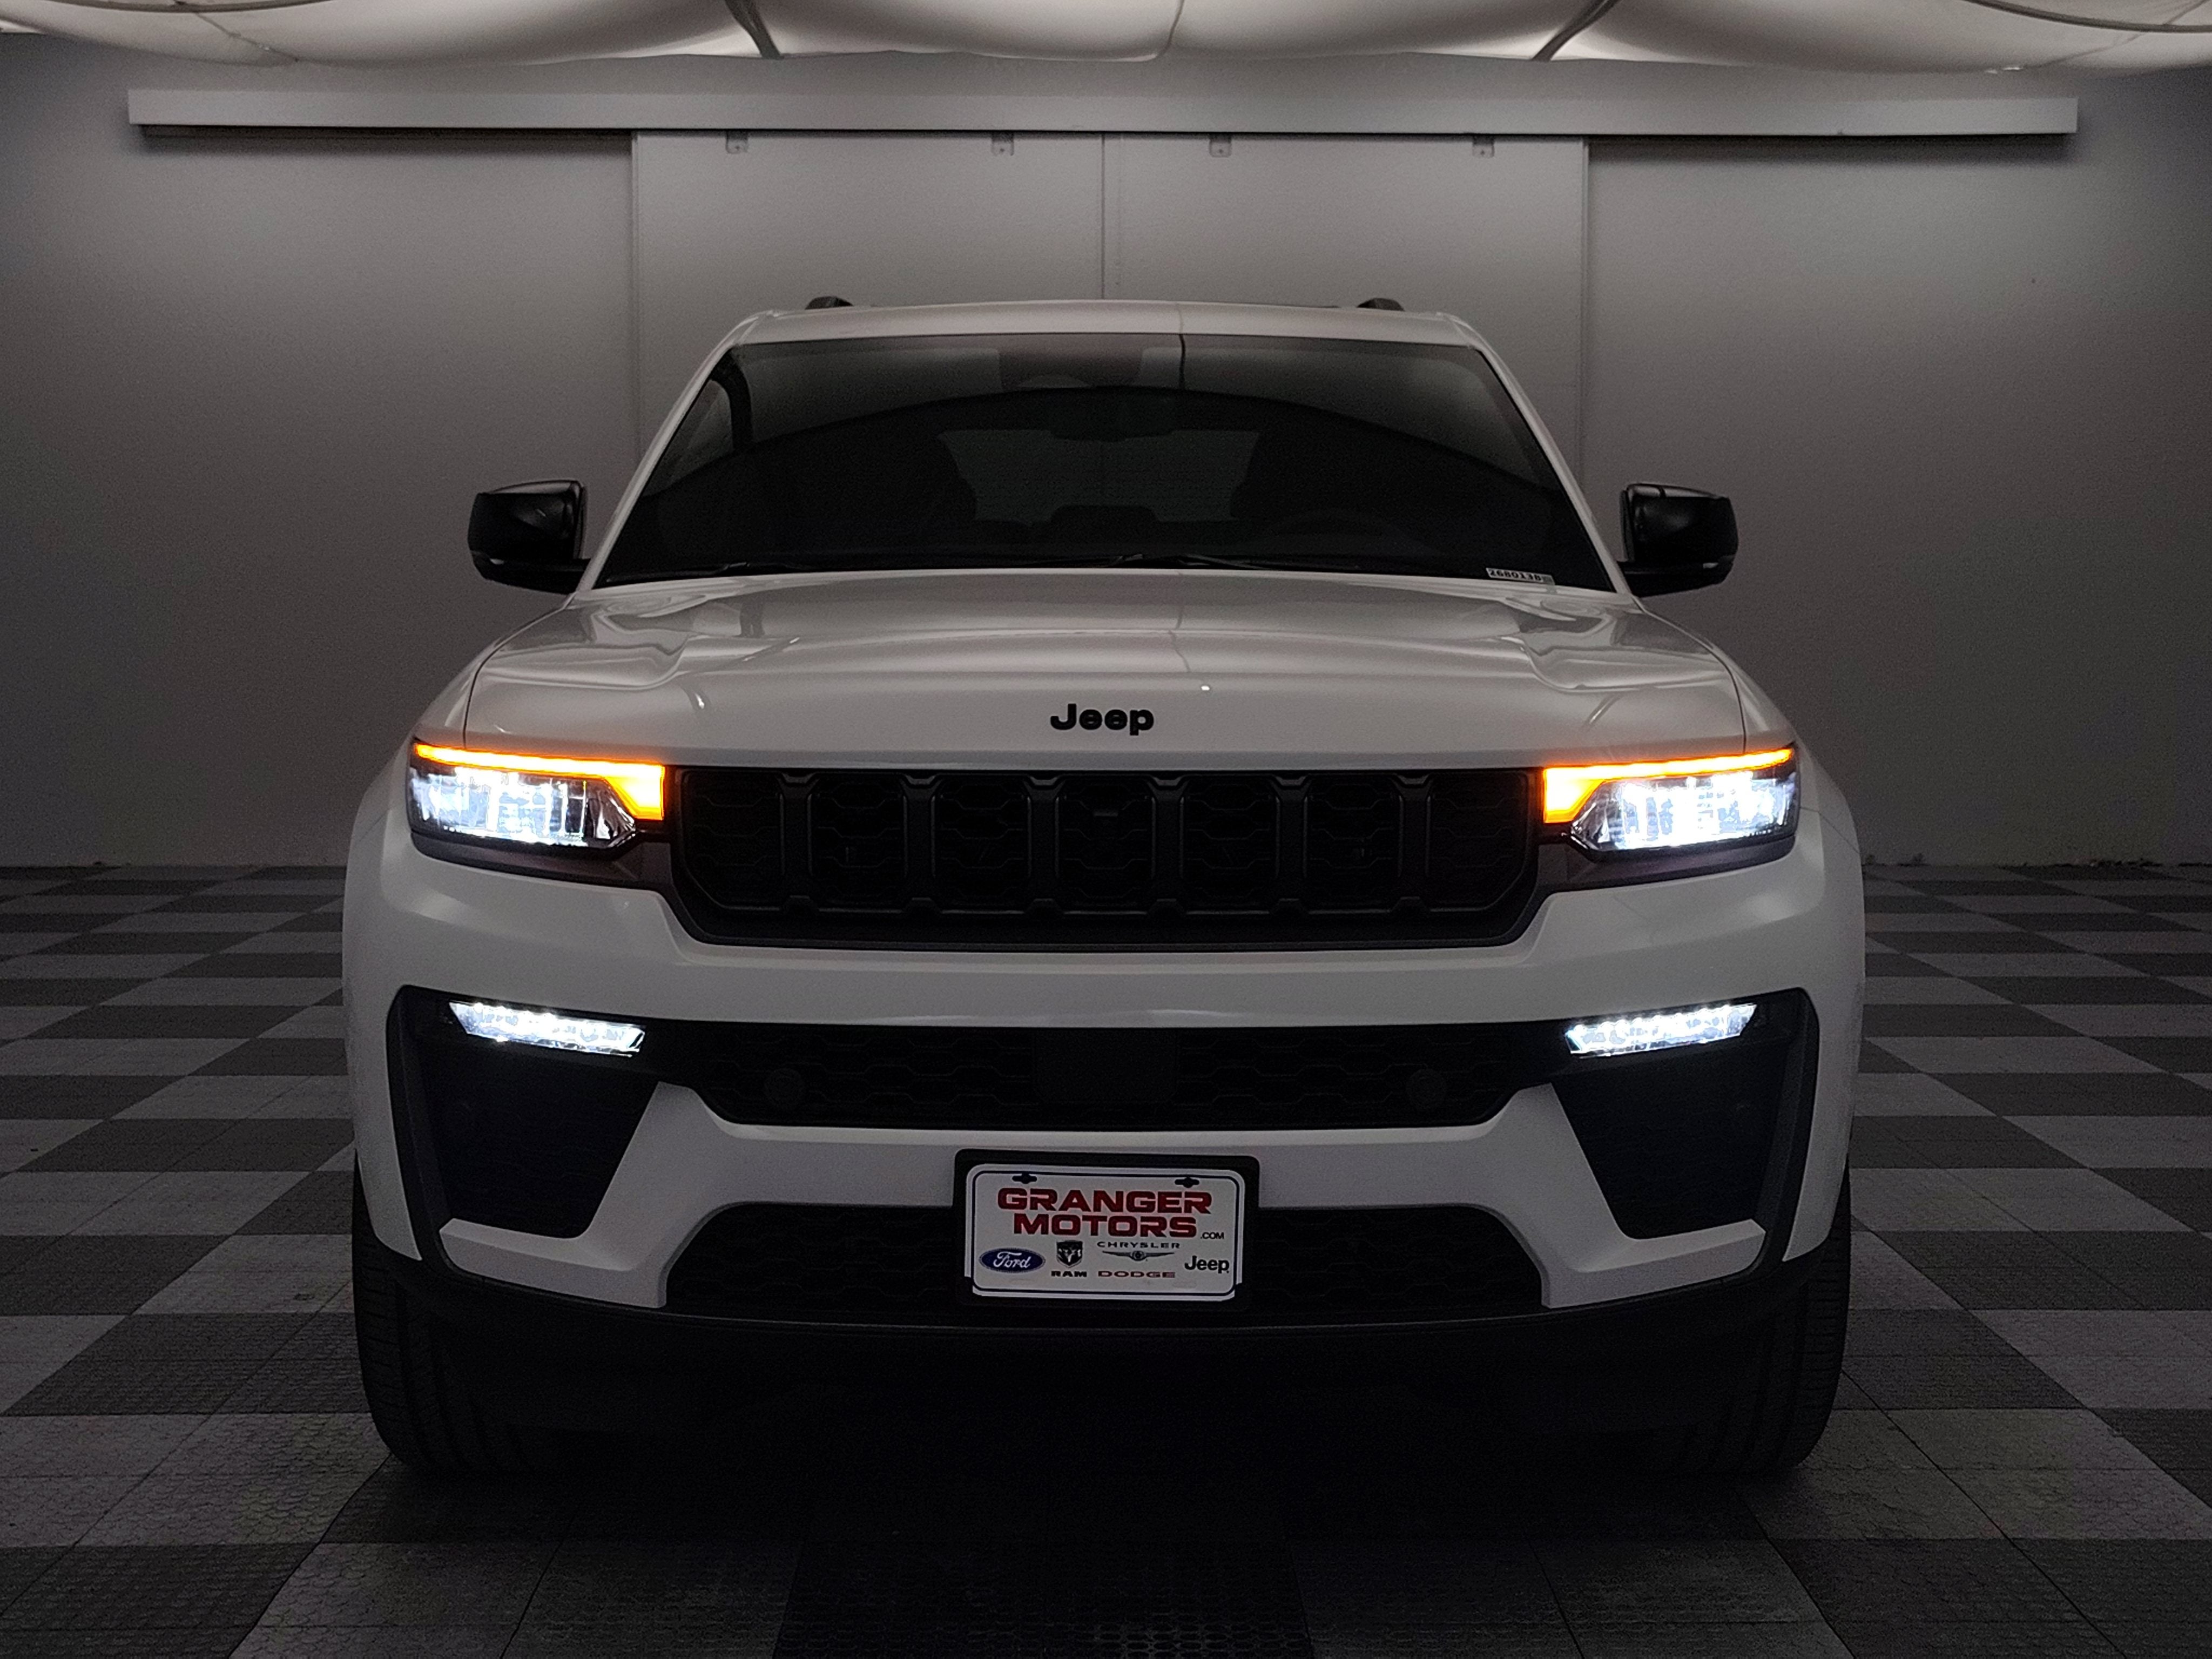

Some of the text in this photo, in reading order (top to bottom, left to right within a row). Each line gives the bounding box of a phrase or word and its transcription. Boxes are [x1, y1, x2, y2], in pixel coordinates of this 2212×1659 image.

[1050, 703, 1154, 736] Jeep
[997, 1188, 1212, 1214] GRANGER
[1014, 1213, 1225, 1240] MOTORS .COM
[1097, 1241, 1180, 1249] CHRYSLER
[993, 1251, 1032, 1269] Ford
[1184, 1255, 1230, 1274] Jeep
